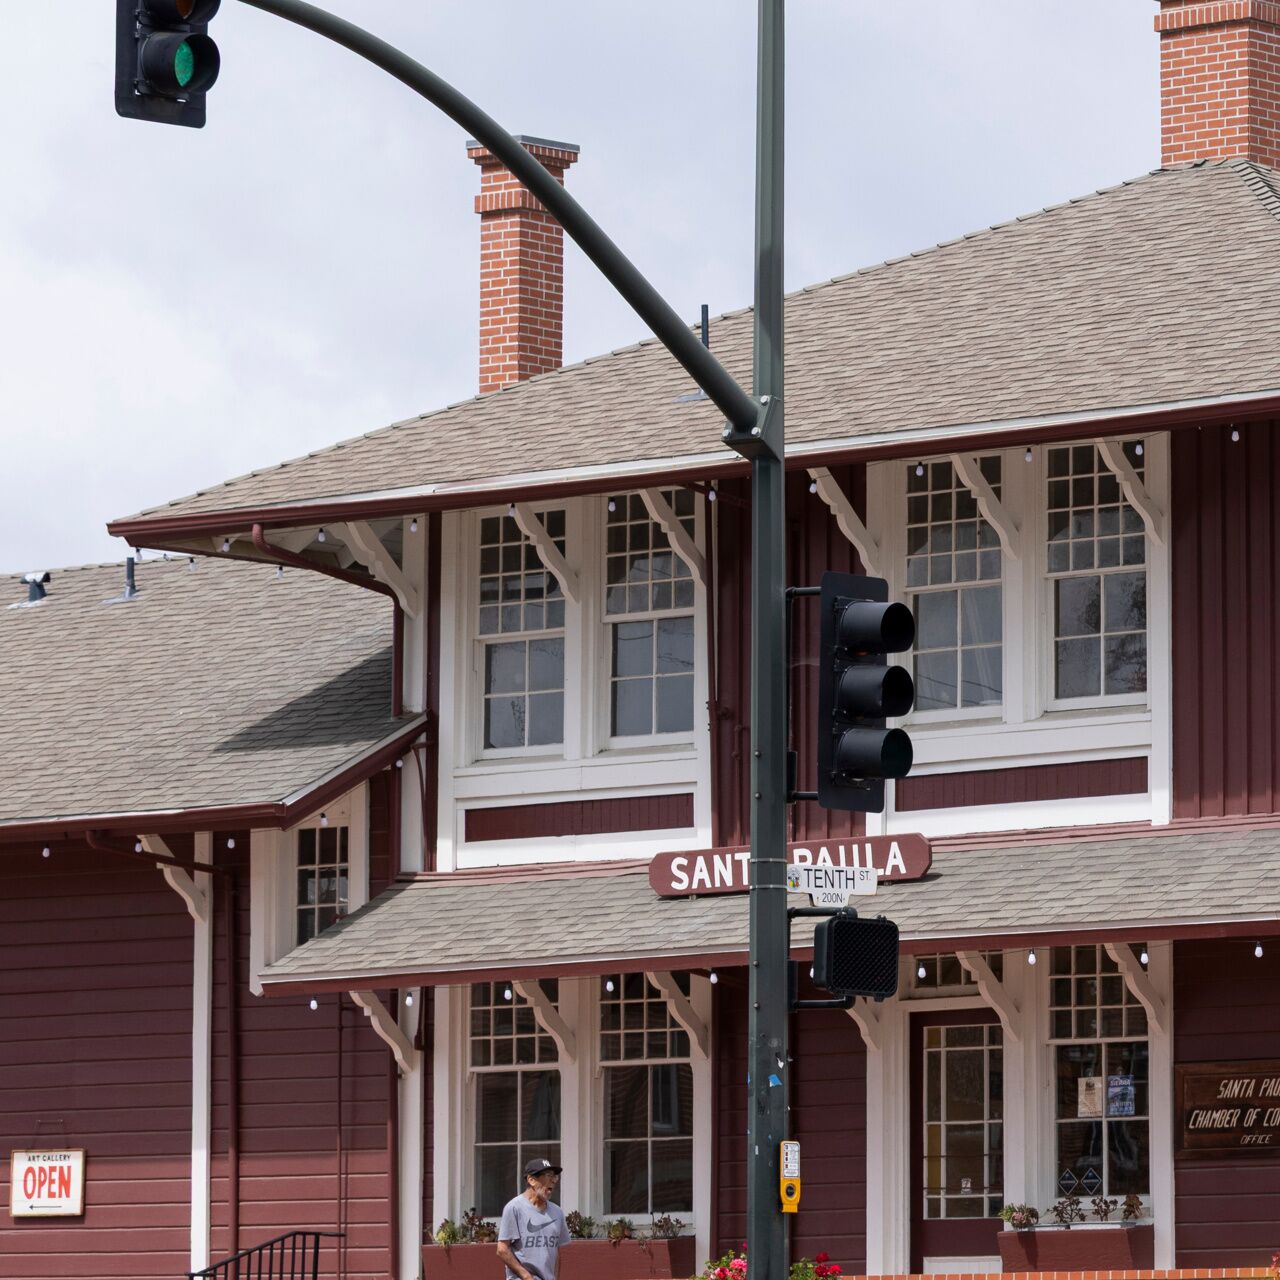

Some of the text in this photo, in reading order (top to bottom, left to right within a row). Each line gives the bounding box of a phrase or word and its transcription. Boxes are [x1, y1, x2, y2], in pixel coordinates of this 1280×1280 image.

[671, 852, 750, 891] SANT
[803, 868, 872, 890] TENTH ST.
[1217, 1079, 1256, 1099] SANTA
[1189, 1108, 1241, 1129] CHAMBER
[1243, 1108, 1261, 1127] OF
[1240, 1134, 1273, 1145] OFFICE
[23, 1165, 72, 1200] OPEN
